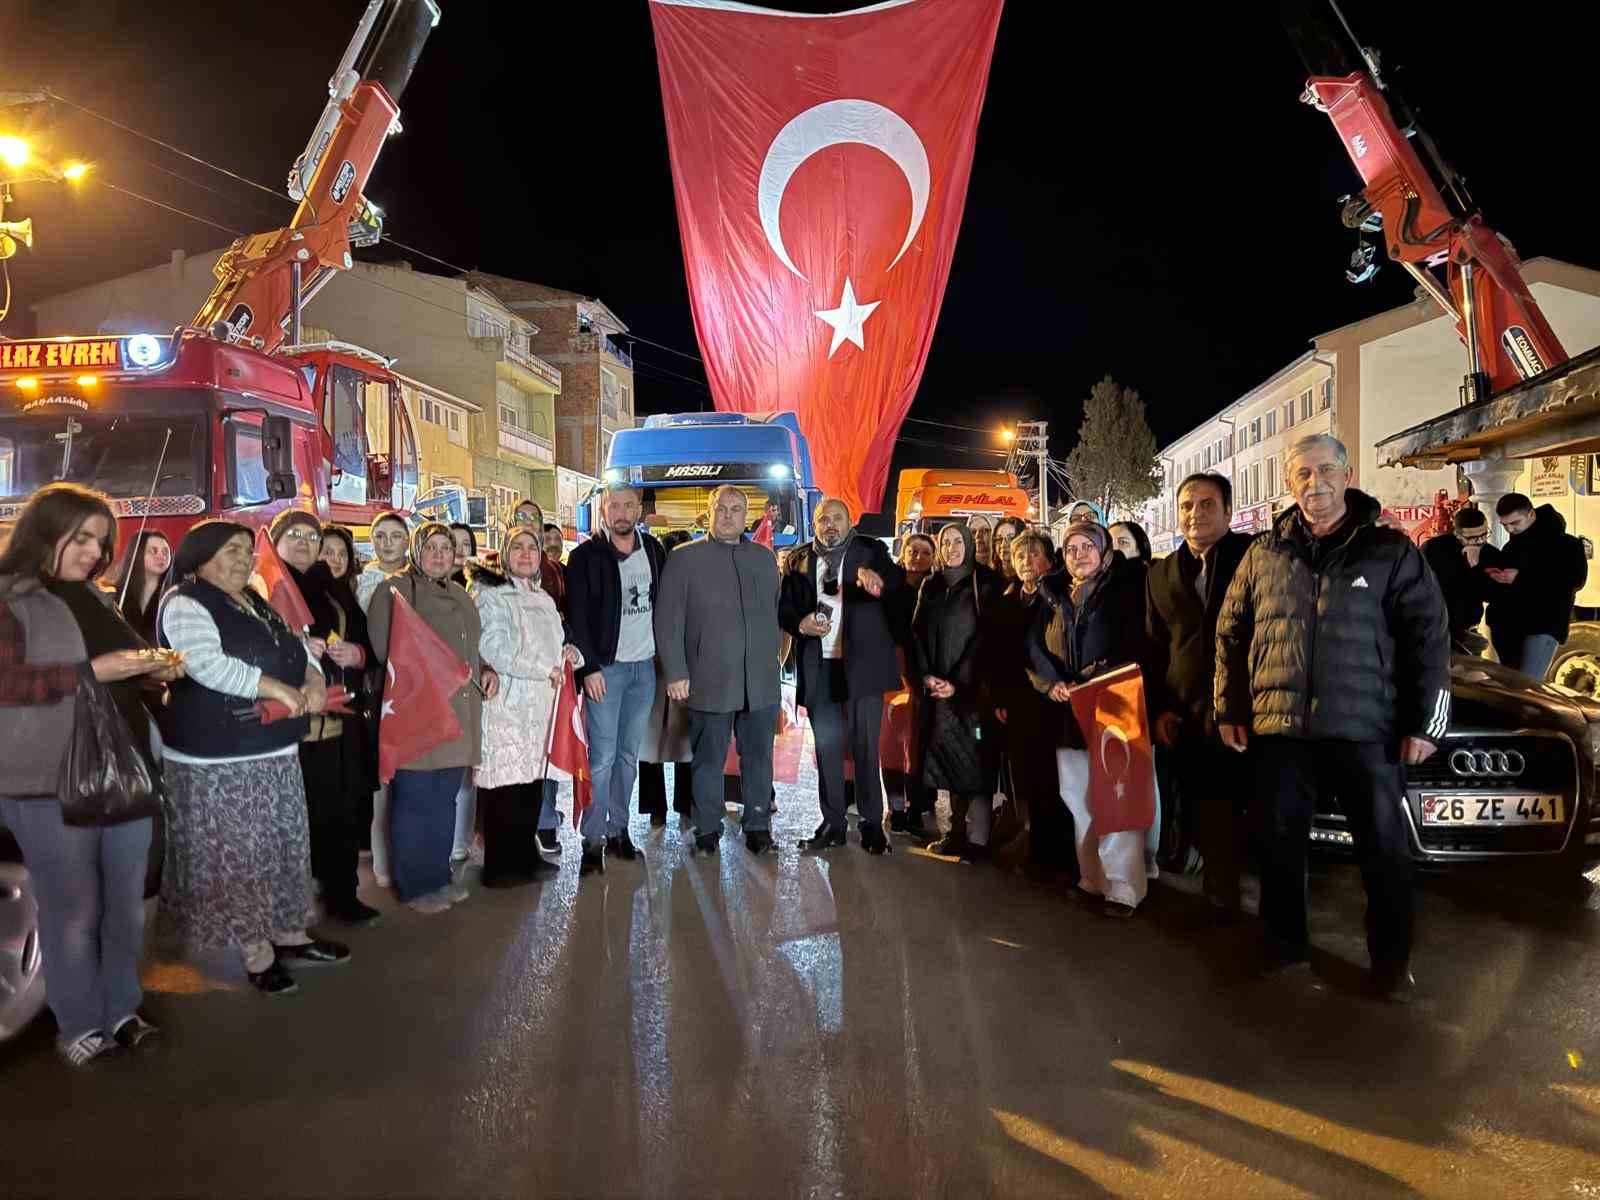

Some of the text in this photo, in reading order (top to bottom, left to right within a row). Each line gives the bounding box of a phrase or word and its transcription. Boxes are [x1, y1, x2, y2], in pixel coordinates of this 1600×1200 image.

[0, 341, 118, 368] LAZ EVREN
[1437, 798, 1557, 821] 26 ZE 441
